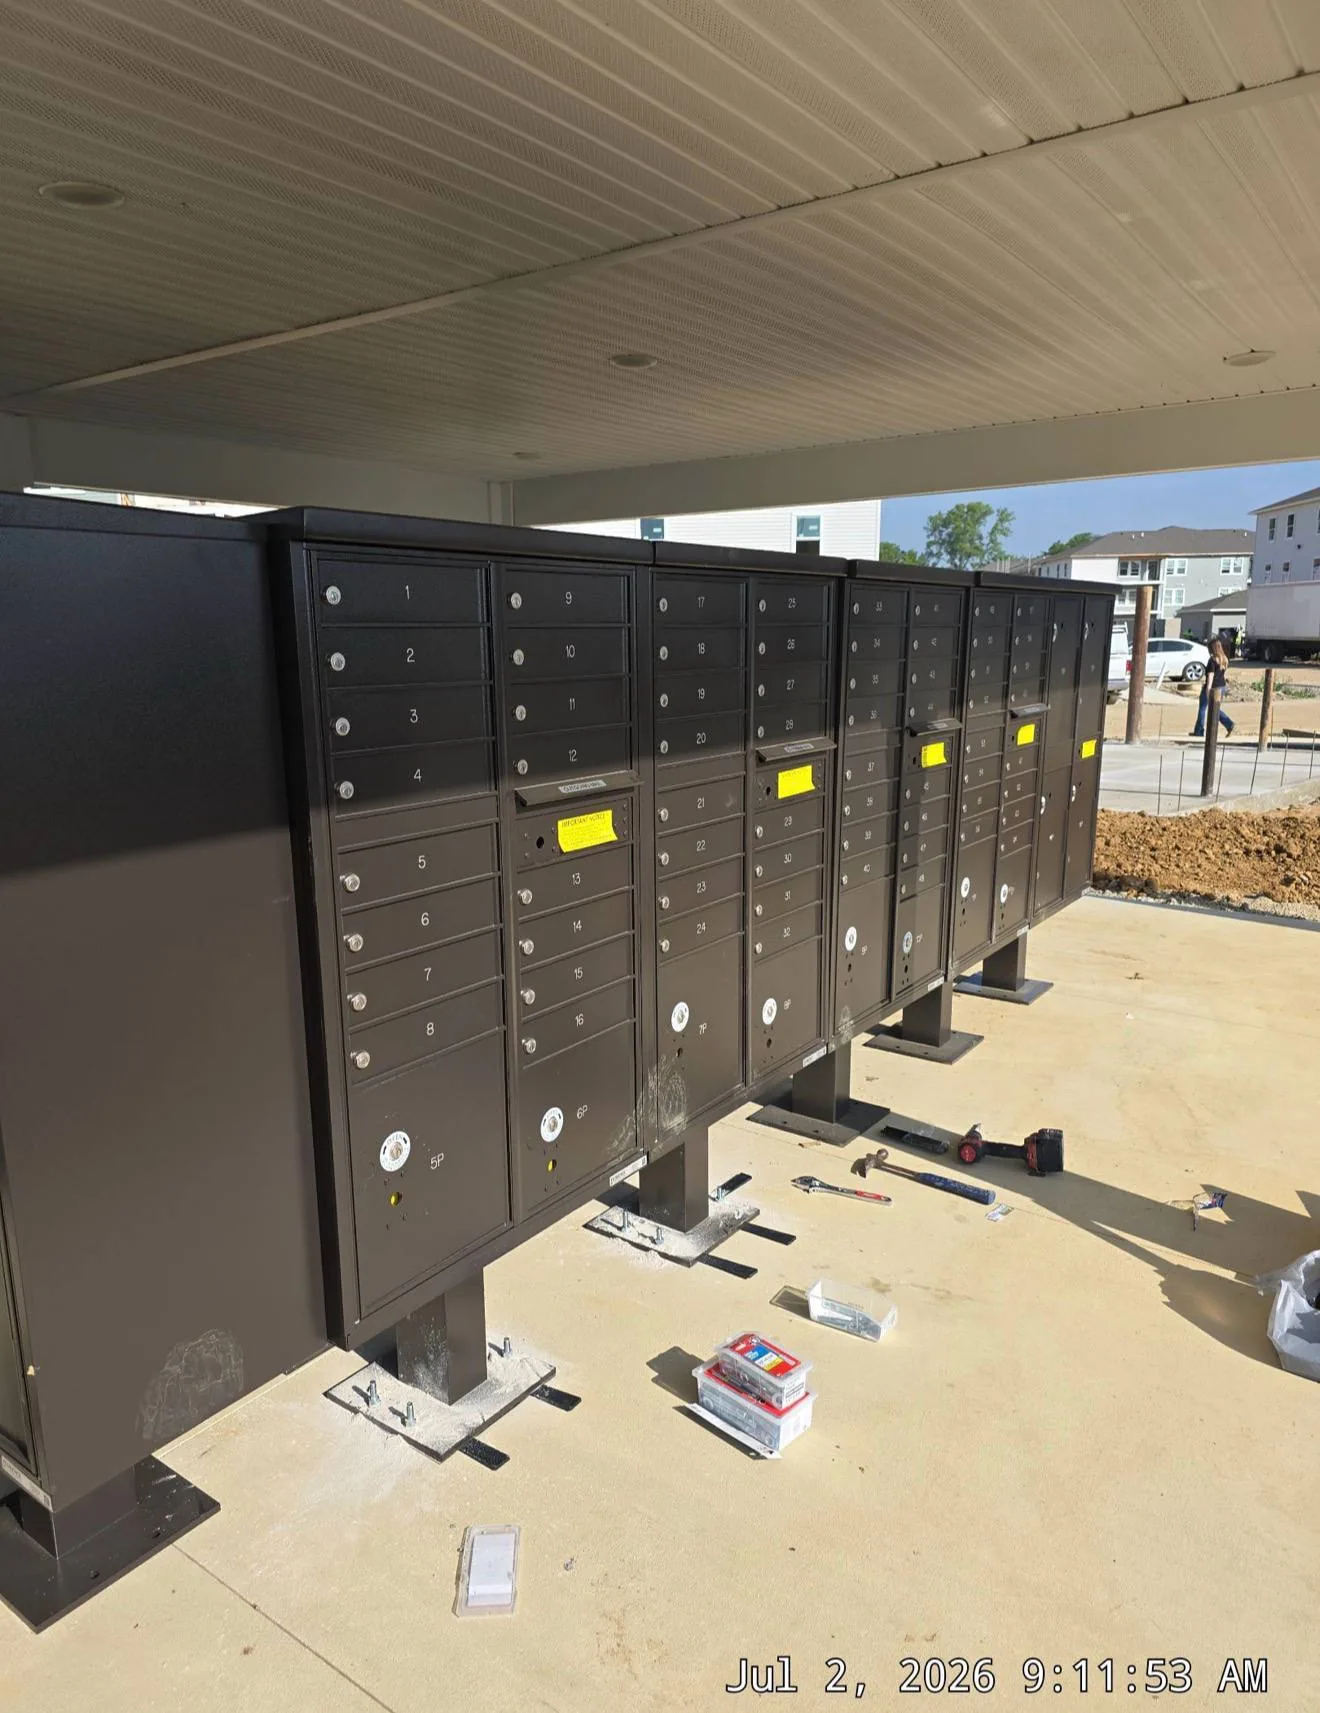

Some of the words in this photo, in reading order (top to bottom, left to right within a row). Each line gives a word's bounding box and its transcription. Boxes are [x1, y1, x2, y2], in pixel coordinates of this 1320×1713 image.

[405, 584, 410, 600] 1
[565, 591, 573, 605] 9
[697, 596, 705, 609] 17
[406, 647, 415, 663] 2
[565, 644, 576, 658] 10
[698, 642, 706, 655] 18
[786, 679, 795, 691] 27
[697, 687, 705, 700] 19
[569, 697, 576, 711] 11
[410, 708, 419, 724] 3
[696, 732, 707, 745] 20
[568, 748, 577, 762] 12
[413, 768, 422, 783] 4
[696, 797, 705, 809] 21
[696, 839, 706, 852] 22
[418, 855, 427, 869] 5
[783, 852, 792, 864] 30
[572, 872, 581, 885] 13
[696, 880, 707, 894] 23
[420, 912, 430, 926] 6
[573, 919, 582, 933] 14
[696, 921, 706, 935] 24
[424, 967, 432, 982] 7
[574, 966, 584, 980] 15
[575, 1013, 584, 1027] 16
[426, 1022, 435, 1036] 8
[576, 1104, 588, 1120] 6P
[430, 1152, 445, 1170] 5P
